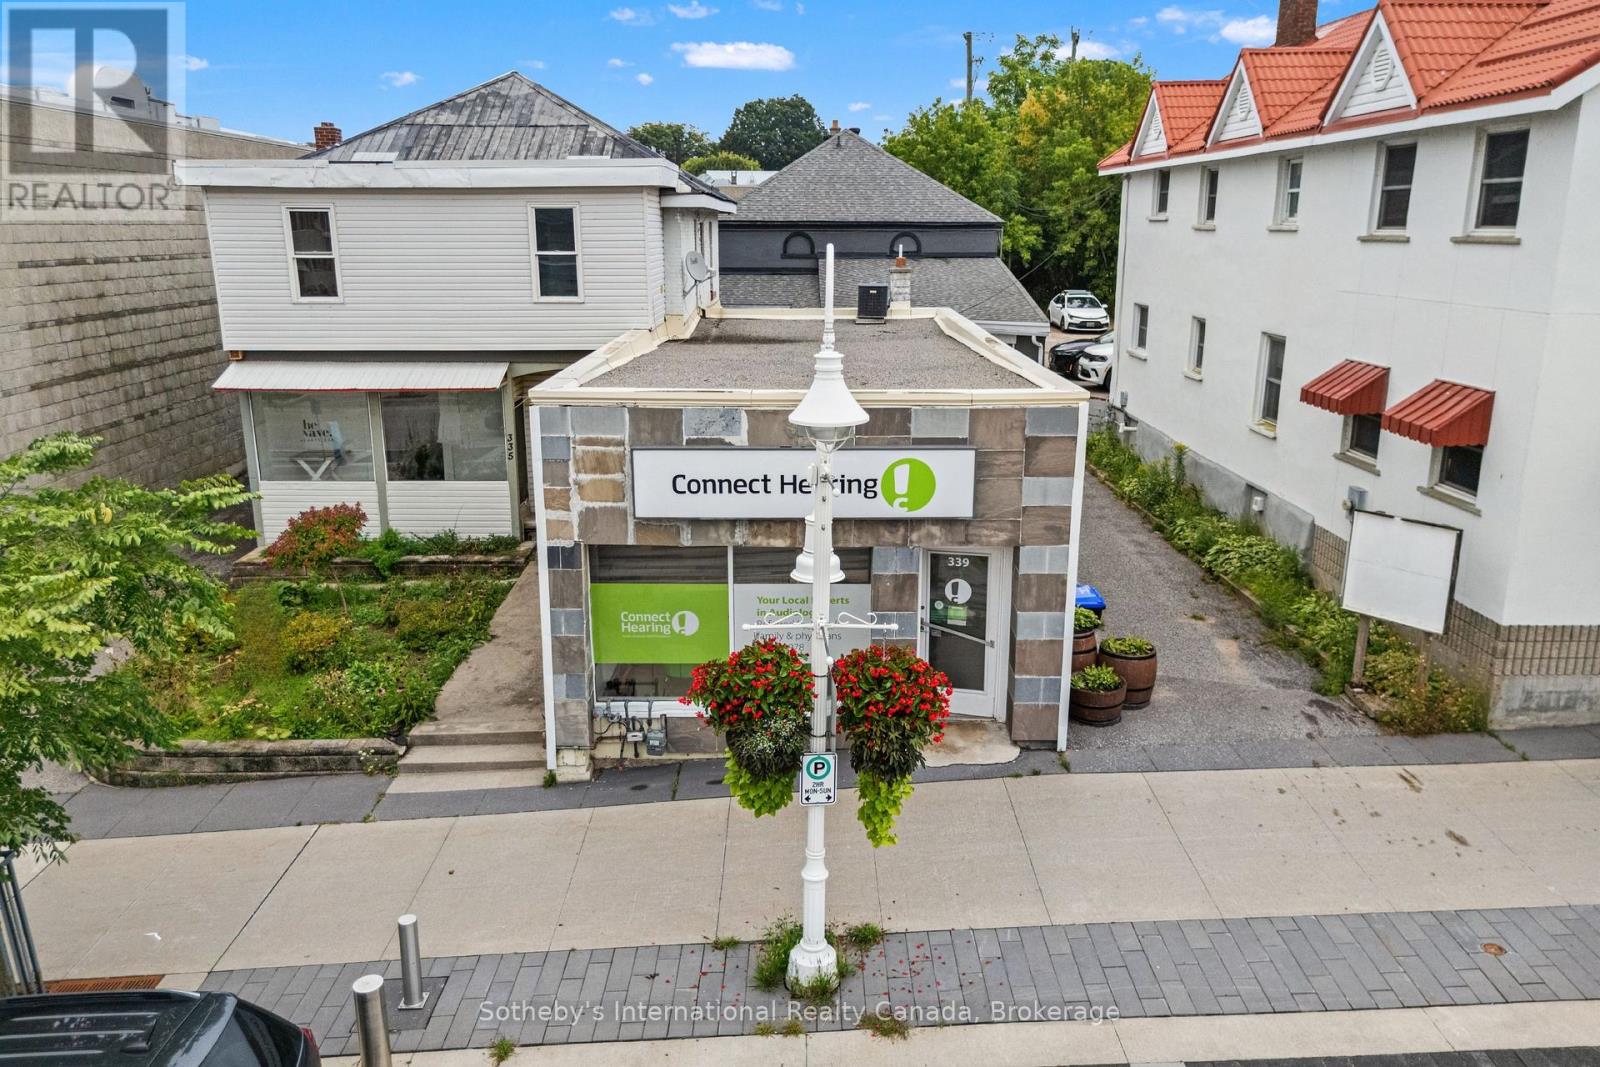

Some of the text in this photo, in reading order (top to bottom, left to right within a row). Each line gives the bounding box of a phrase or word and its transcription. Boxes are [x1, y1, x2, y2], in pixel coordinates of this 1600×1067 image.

[672, 474, 878, 499] Connect Heing
[947, 557, 970, 567] 339
[757, 596, 780, 605] Your
[782, 596, 809, 605] Local
[620, 611, 671, 622] Connect
[757, 608, 766, 617] in
[621, 622, 672, 635] Hearing
[804, 787, 832, 795] MON-SUN
